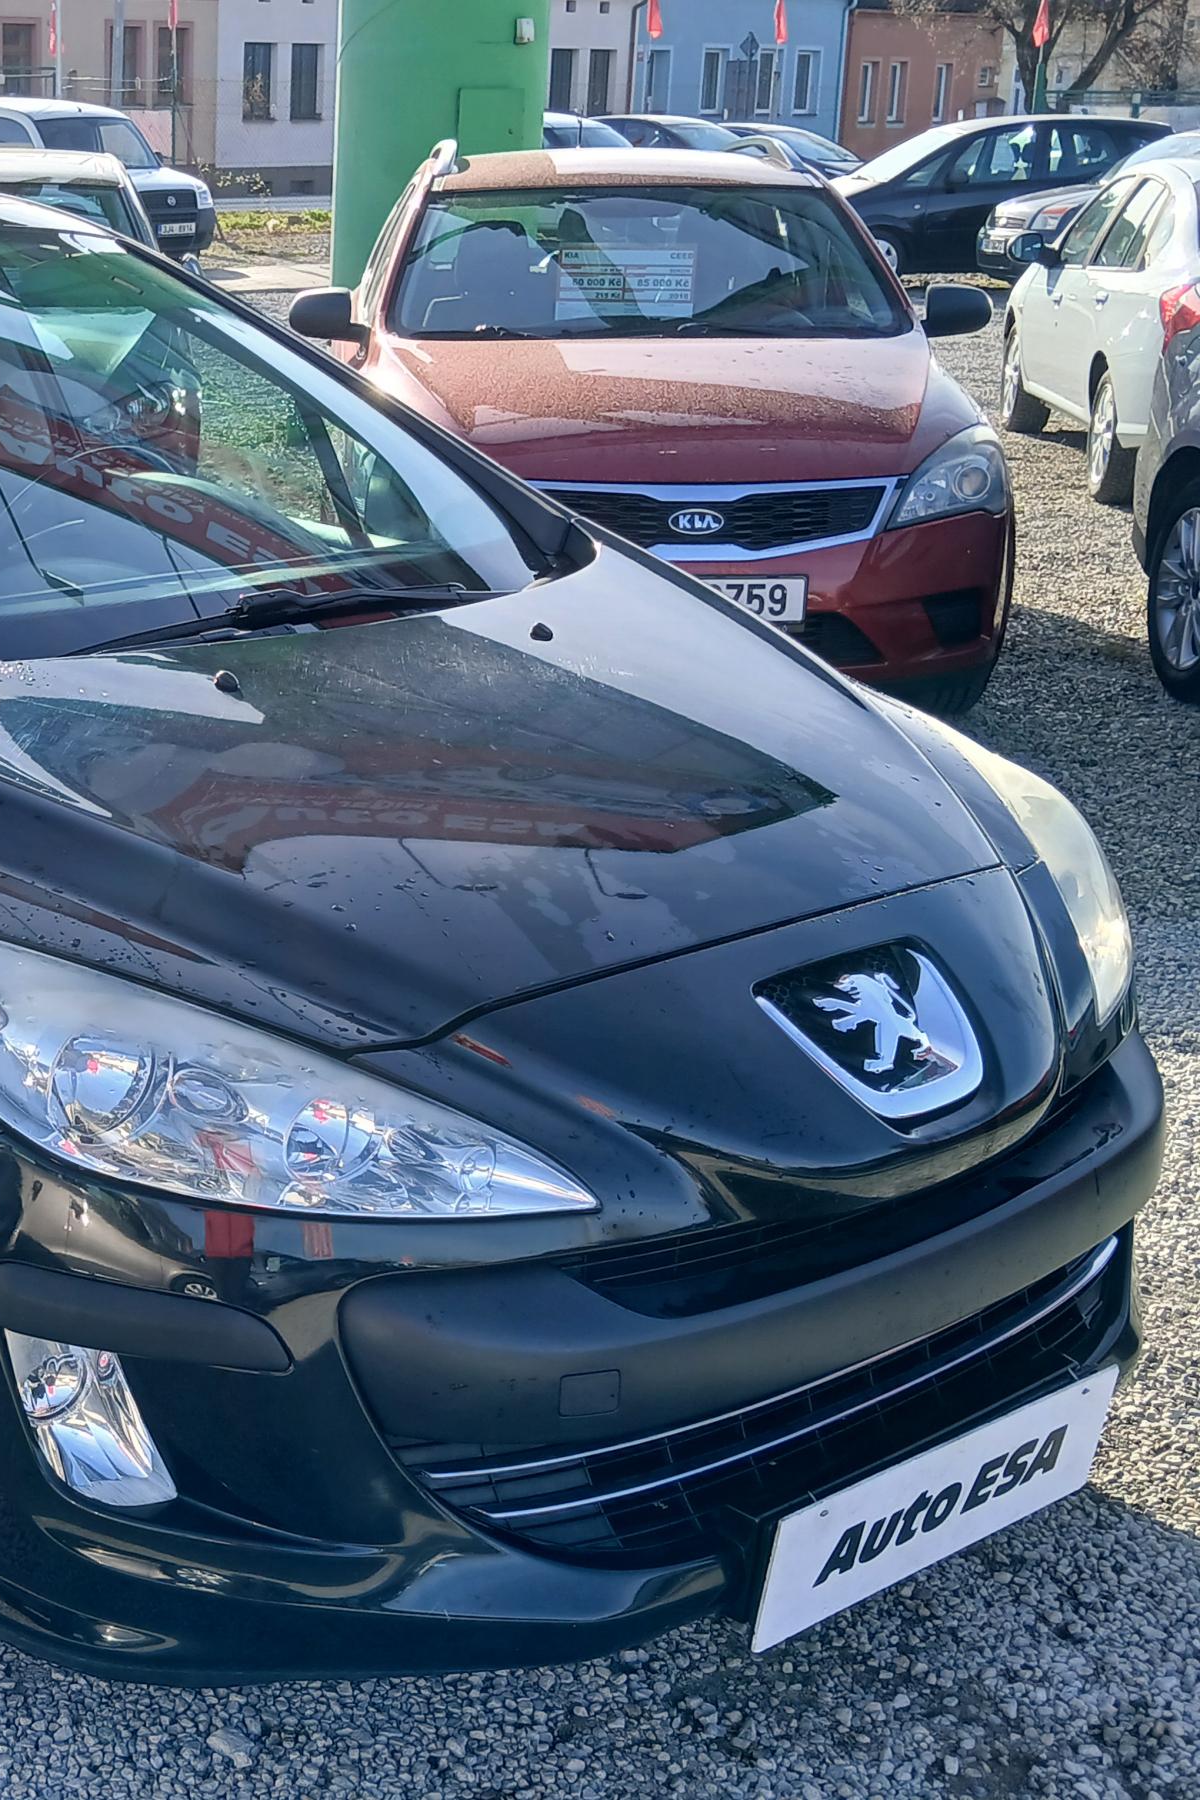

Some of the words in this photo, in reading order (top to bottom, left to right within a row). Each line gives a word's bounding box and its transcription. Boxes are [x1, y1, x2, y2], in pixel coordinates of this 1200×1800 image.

[587, 278, 606, 286] 000
[653, 278, 672, 287] 000
[678, 514, 719, 529] KIA
[711, 583, 788, 617] 759
[813, 1482, 963, 1588] Auto
[960, 1425, 1068, 1514] ESA
